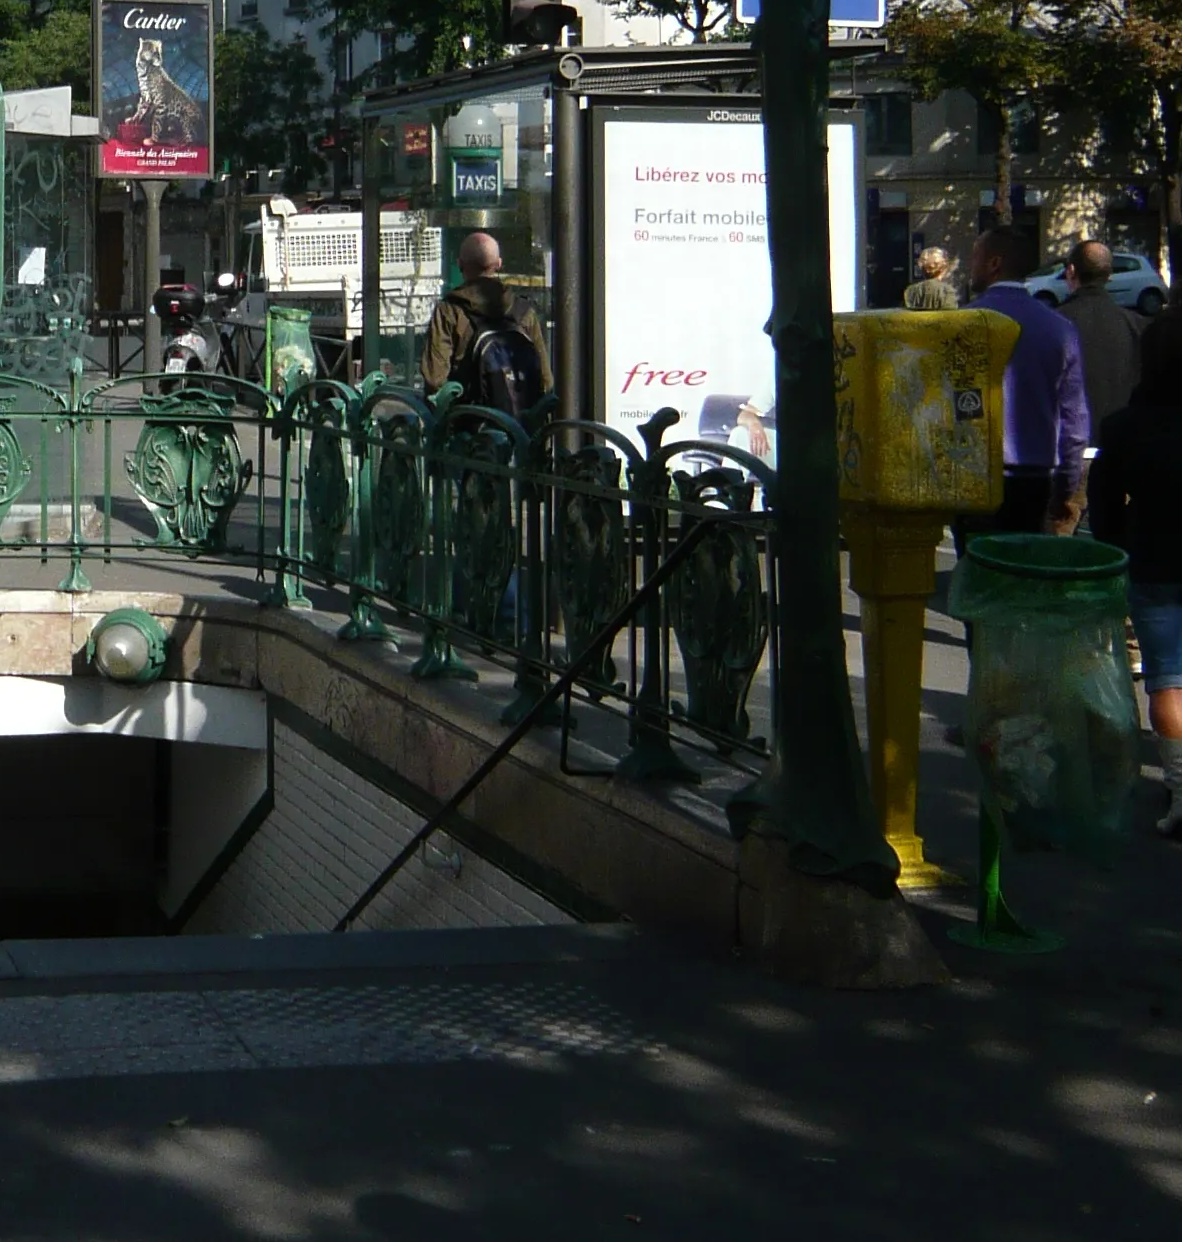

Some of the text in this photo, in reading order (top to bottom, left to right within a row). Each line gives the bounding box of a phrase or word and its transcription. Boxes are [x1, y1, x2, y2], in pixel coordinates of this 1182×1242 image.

[123, 8, 187, 31] Cartier
[464, 134, 493, 147] TAXIS
[457, 174, 496, 191] TAXIS
[635, 166, 699, 182] Libérez
[706, 171, 736, 183] vos
[635, 208, 766, 226] Forfait mobile
[634, 230, 649, 242] 60
[729, 231, 744, 243] 60
[621, 362, 707, 394] free
